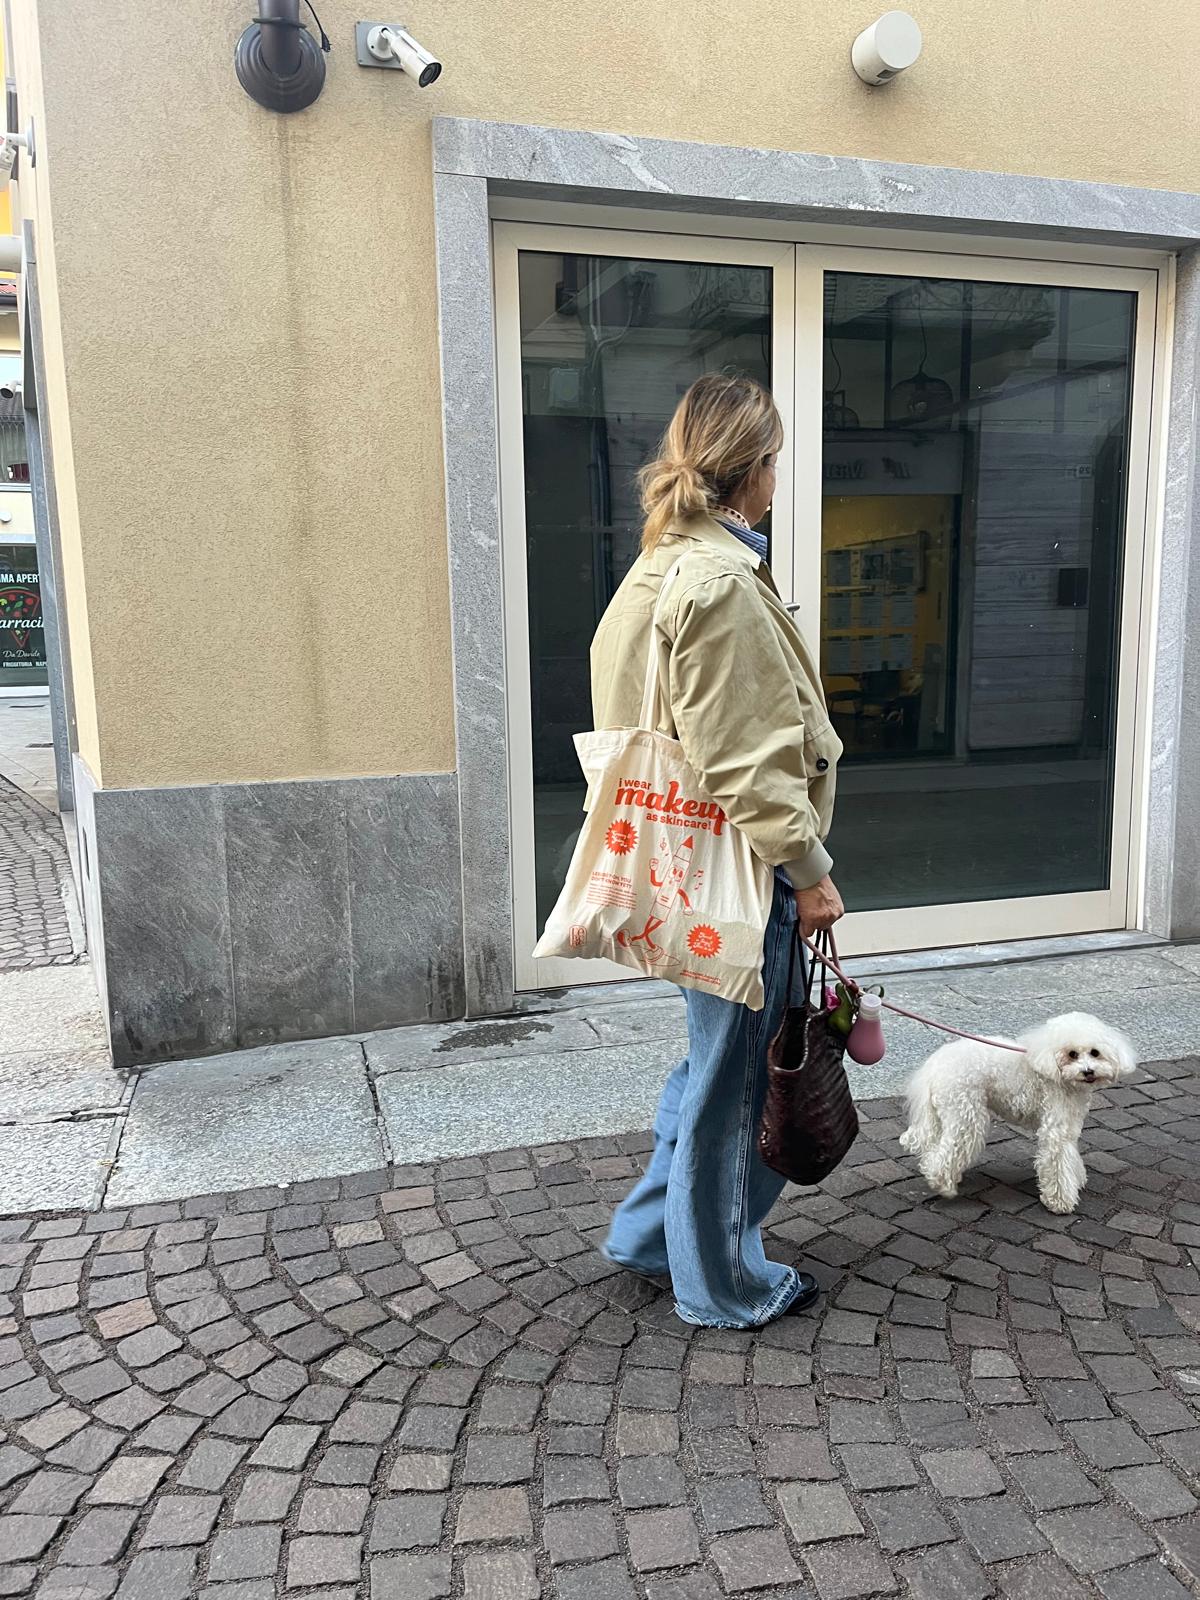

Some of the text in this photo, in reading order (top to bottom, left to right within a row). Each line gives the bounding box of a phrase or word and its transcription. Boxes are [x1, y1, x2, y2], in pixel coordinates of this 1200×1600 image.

[0, 573, 40, 583] MA APER
[0, 616, 45, 629] arraci
[624, 780, 652, 790] wear
[646, 811, 712, 831] as skincare!
